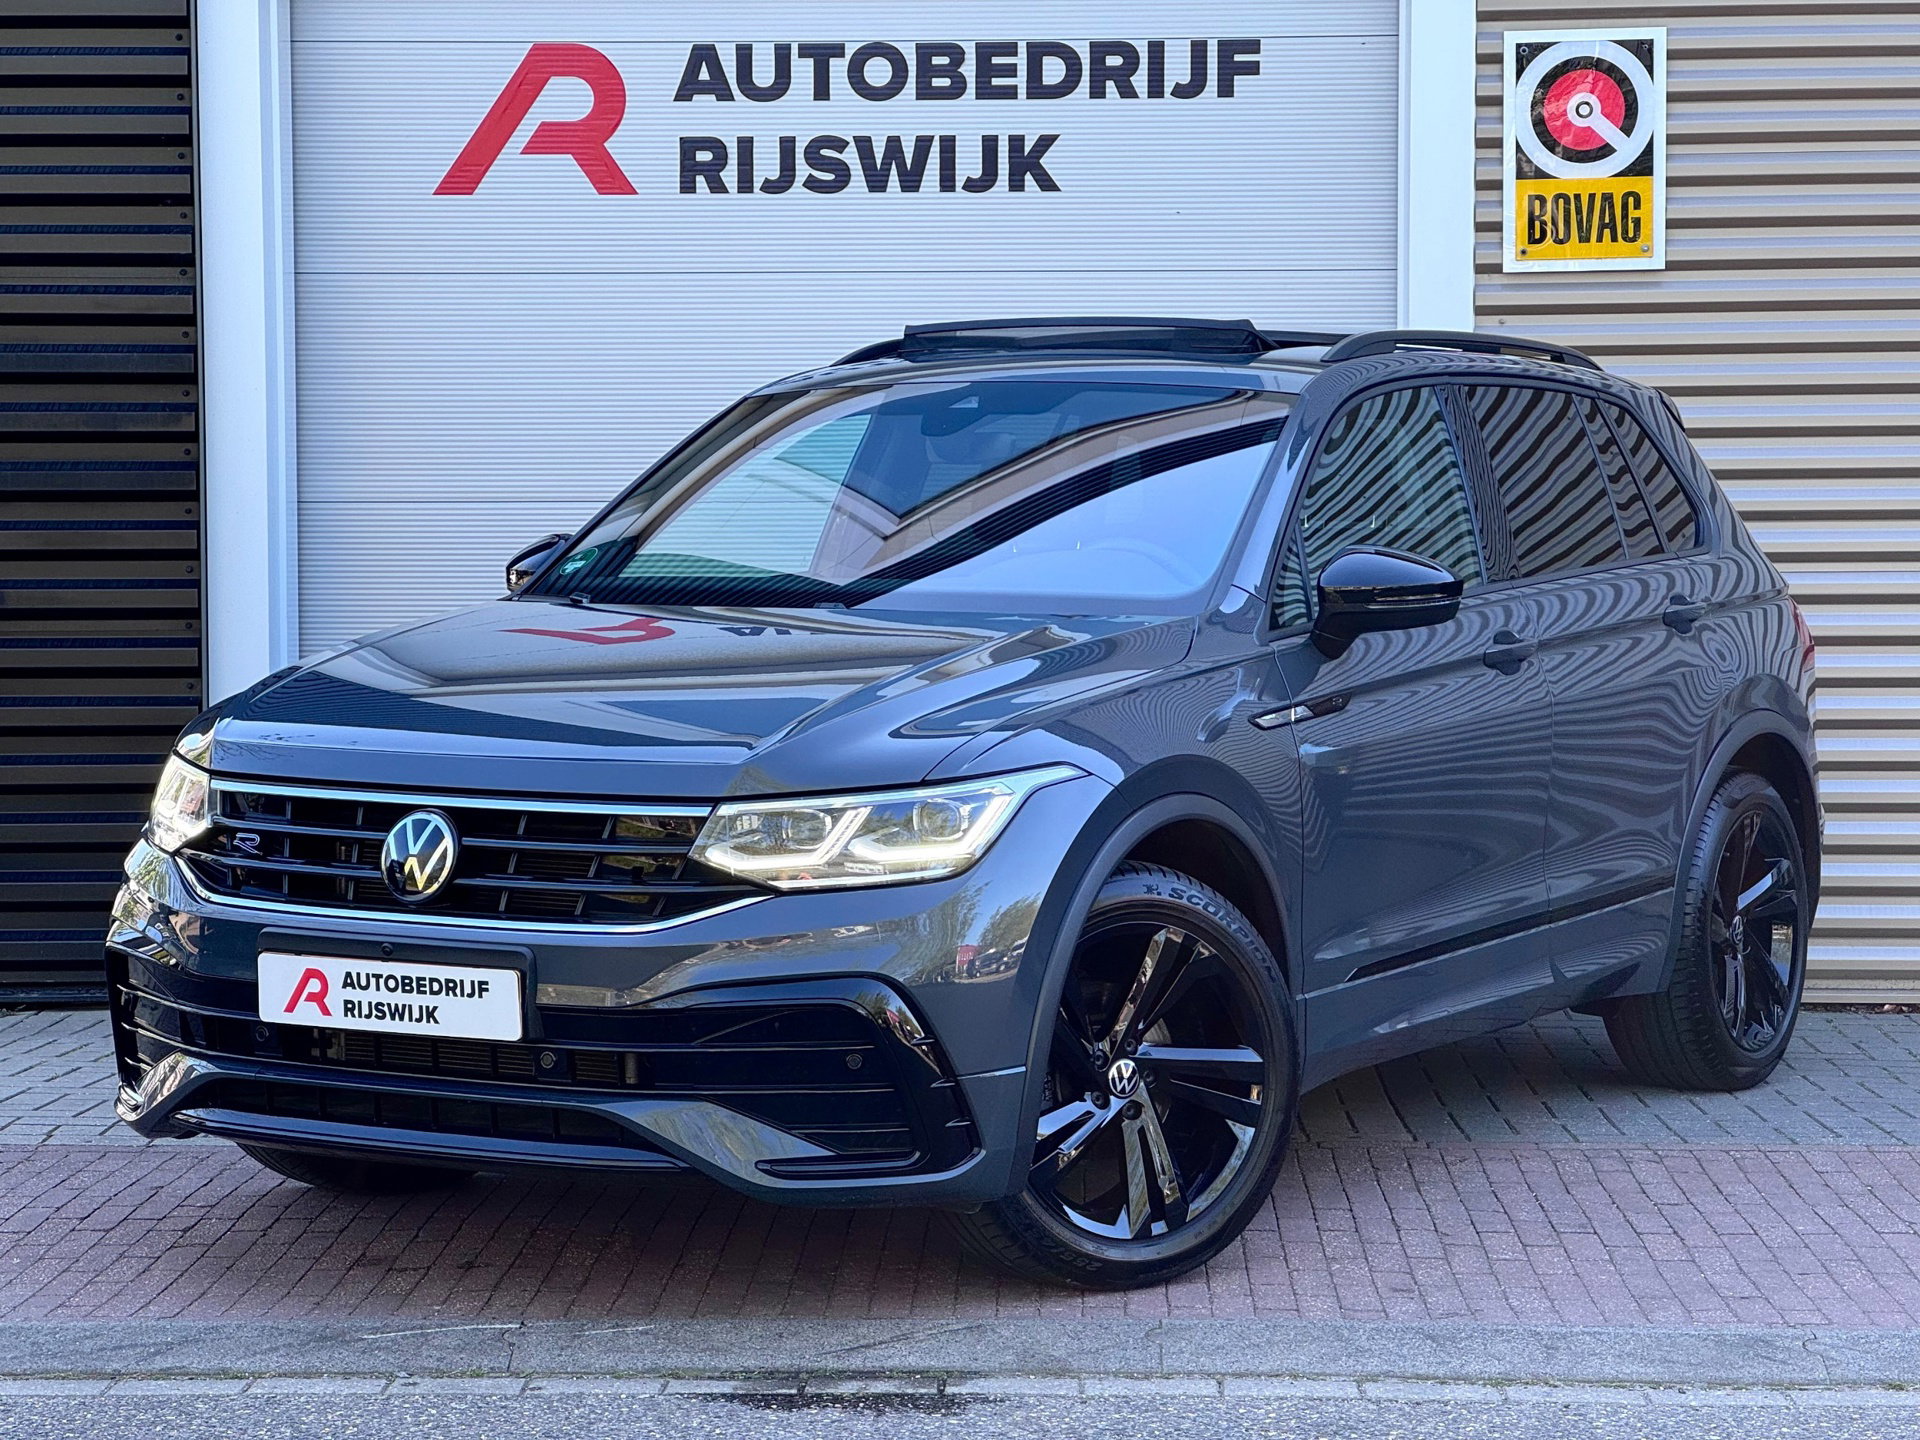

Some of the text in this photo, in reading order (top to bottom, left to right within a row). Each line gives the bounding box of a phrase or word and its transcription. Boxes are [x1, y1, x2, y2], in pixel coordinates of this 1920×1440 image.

[673, 39, 1261, 103] AUTOBEDRIJF
[680, 134, 1062, 194] RIJSWIJK
[1527, 191, 1642, 245] BOVAG
[1168, 887, 1277, 984] SCORPION
[341, 971, 490, 999] AUTOBEDRIJF
[343, 999, 440, 1025] RIJSWIJK
